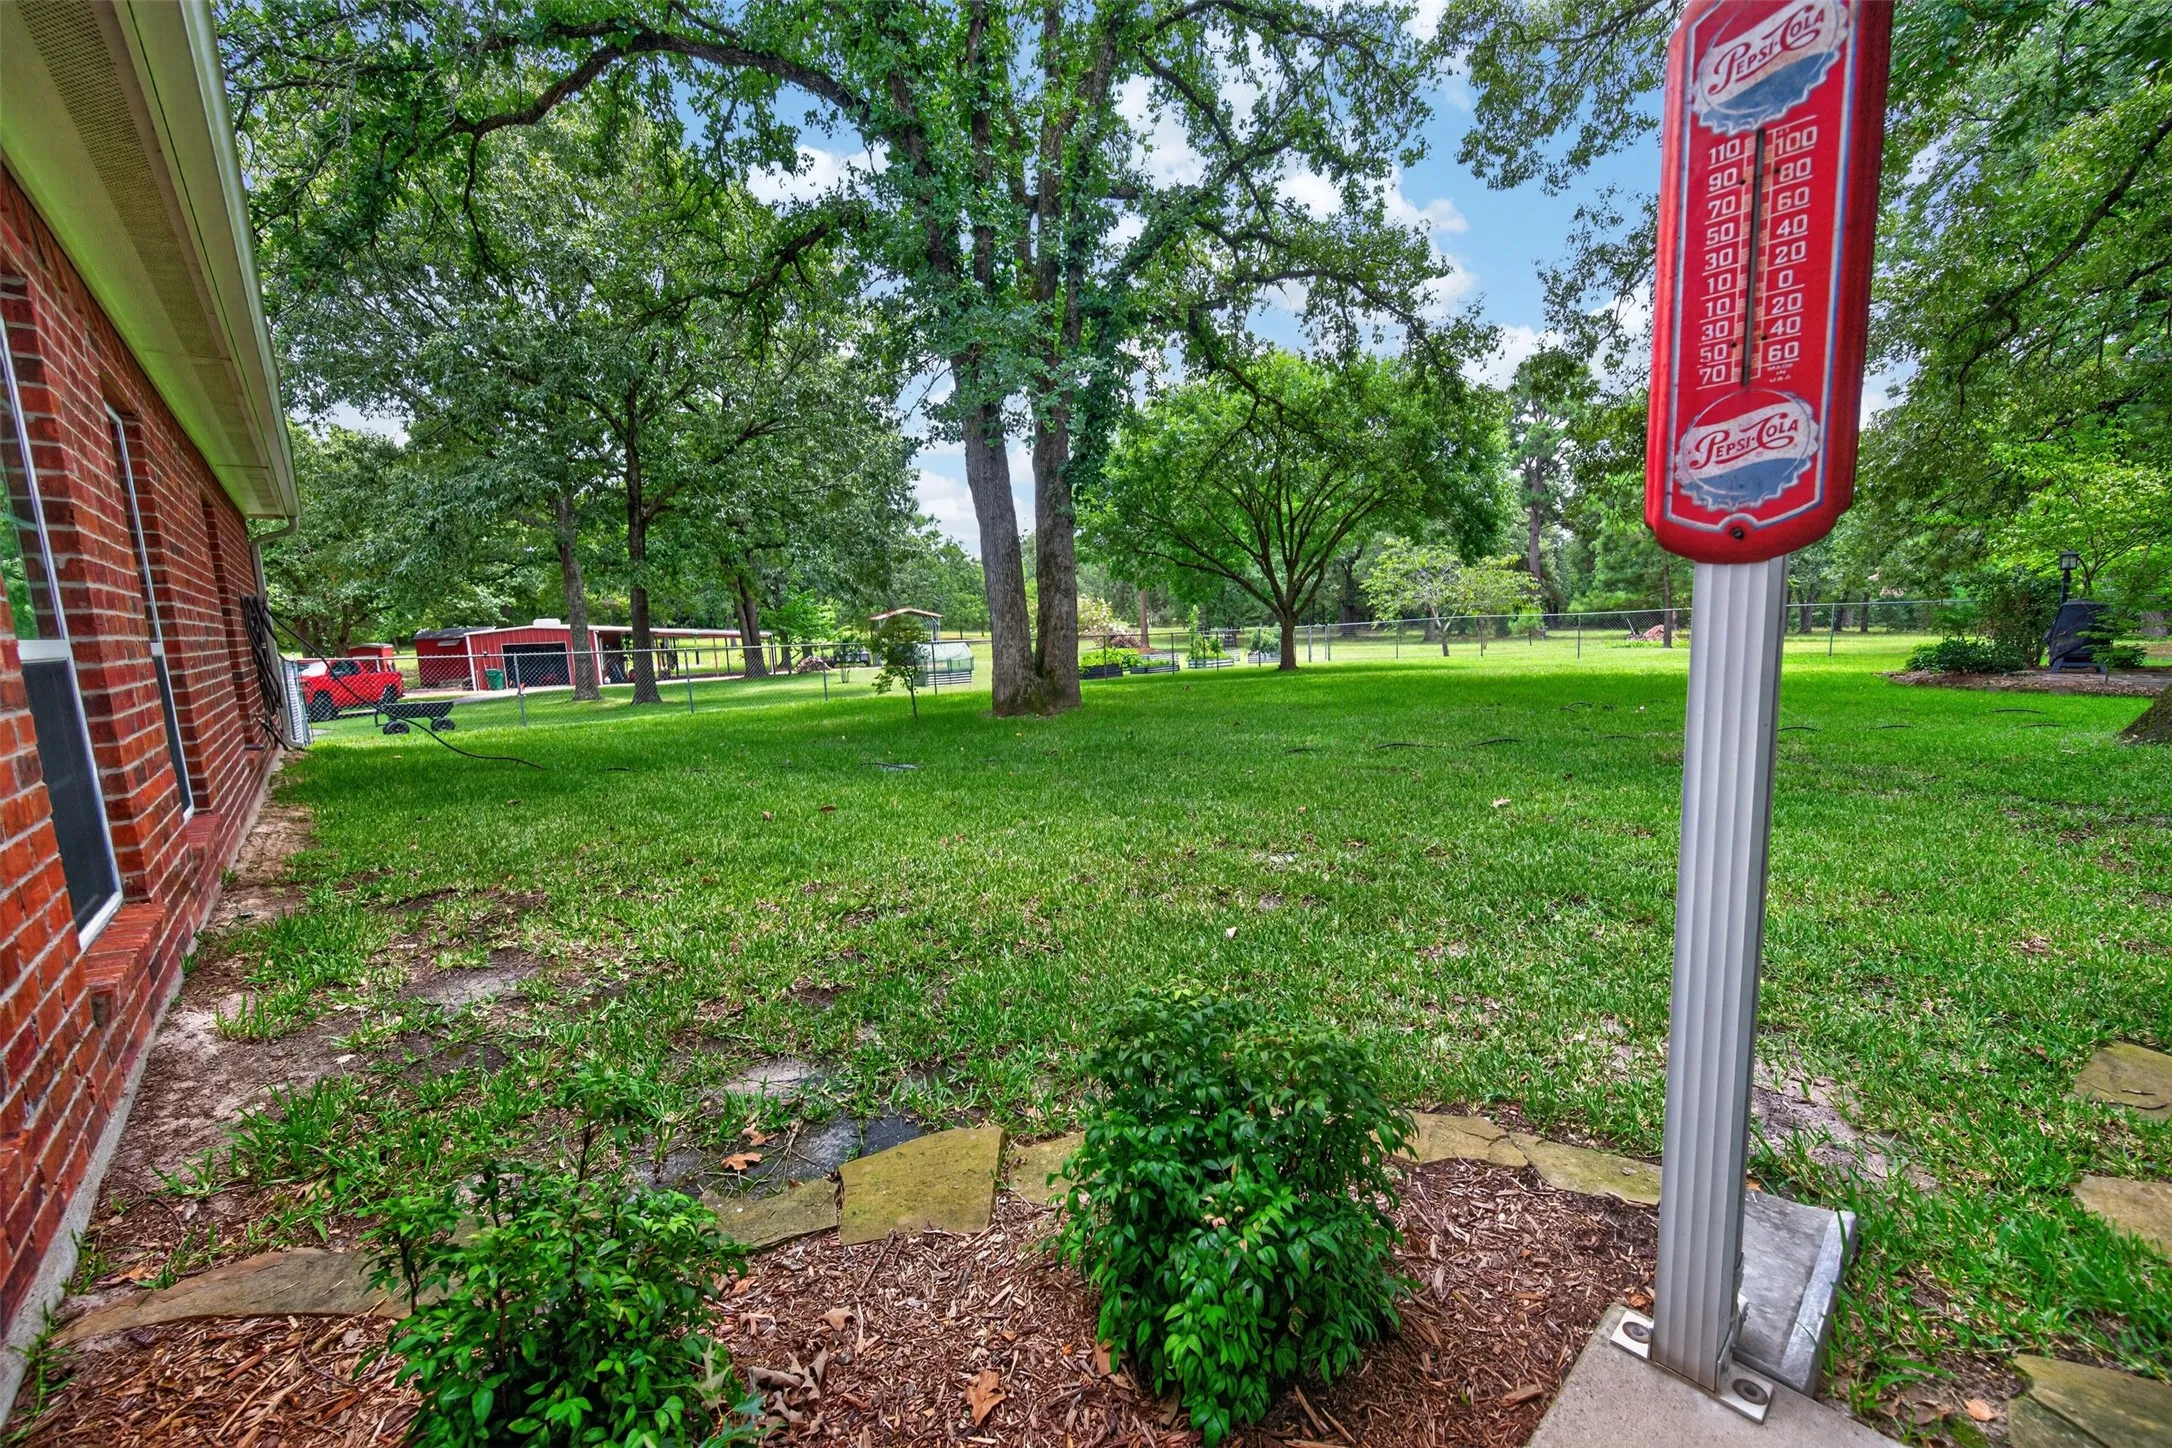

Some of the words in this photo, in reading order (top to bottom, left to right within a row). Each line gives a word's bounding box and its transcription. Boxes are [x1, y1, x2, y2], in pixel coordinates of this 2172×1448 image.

[1708, 138, 1741, 166] 110
[1775, 126, 1818, 155] 100
[1708, 167, 1737, 193] 90
[1778, 157, 1812, 183] 80
[1708, 196, 1736, 220] 70
[1777, 187, 1810, 212] 60
[1706, 223, 1734, 246] 50
[1776, 215, 1809, 238] 40
[1705, 248, 1733, 271] 30
[1774, 241, 1807, 265] 20
[1706, 273, 1732, 292] 10
[1778, 270, 1793, 289] 0
[1705, 297, 1730, 318] 10
[1771, 292, 1803, 315] 20
[1701, 321, 1729, 342] 30
[1769, 317, 1801, 337] 40
[1699, 343, 1728, 364] 50
[1768, 341, 1799, 362] 60
[1700, 364, 1726, 385] 70
